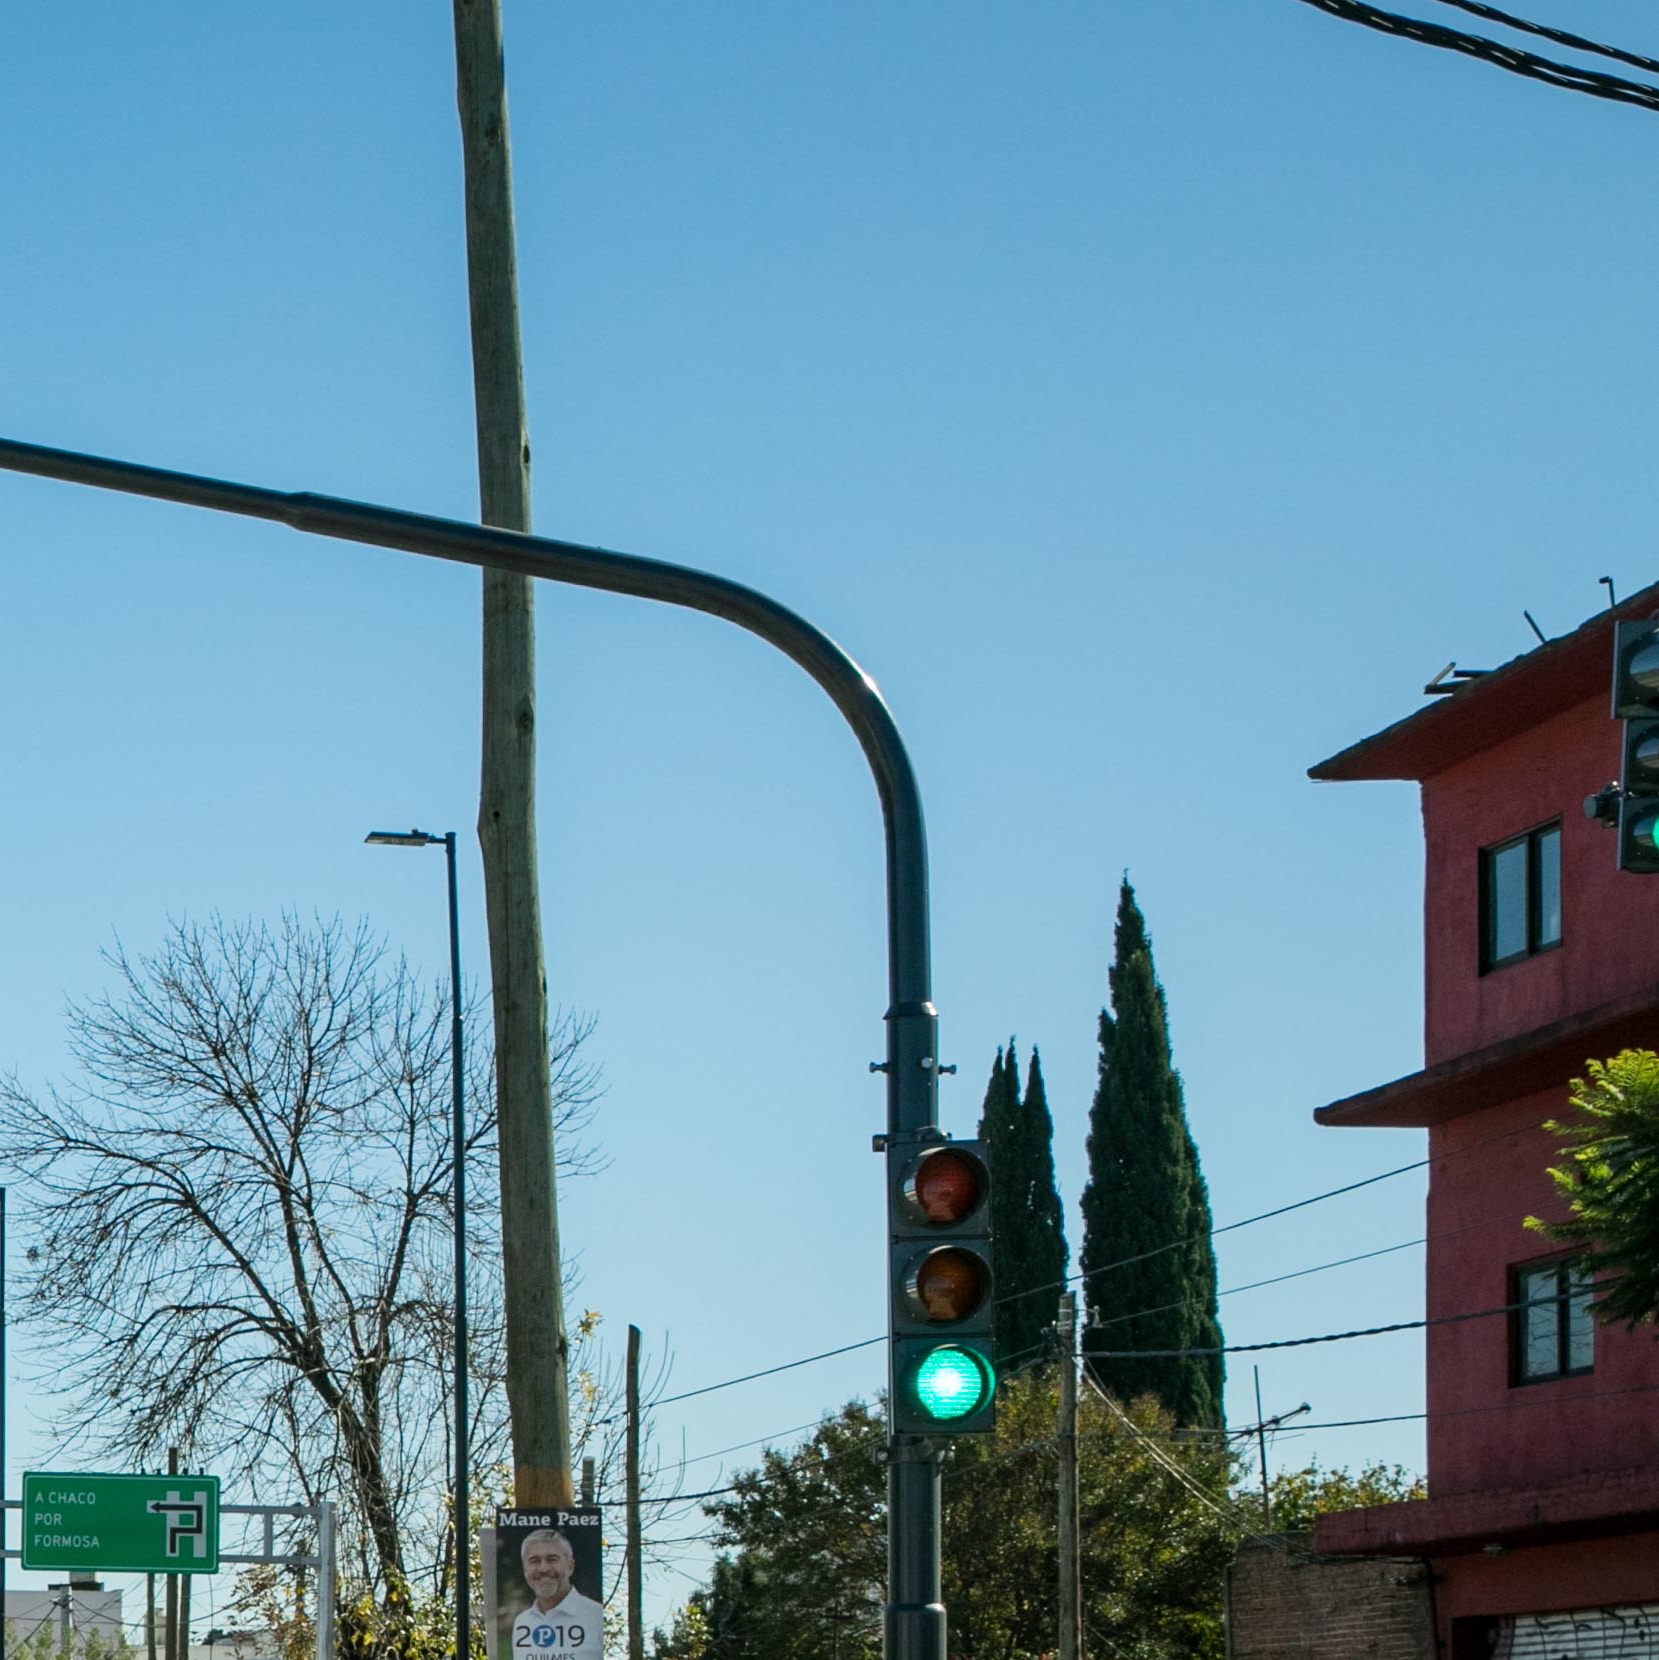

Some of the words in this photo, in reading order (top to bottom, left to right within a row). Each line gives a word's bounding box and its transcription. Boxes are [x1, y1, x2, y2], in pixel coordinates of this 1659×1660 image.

[35, 1491, 44, 1504] A
[48, 1492, 96, 1504] CHACO
[35, 1513, 62, 1525] POR
[499, 1512, 550, 1527] Mane
[557, 1511, 599, 1526] Paez
[34, 1535, 100, 1548] FORMOSA
